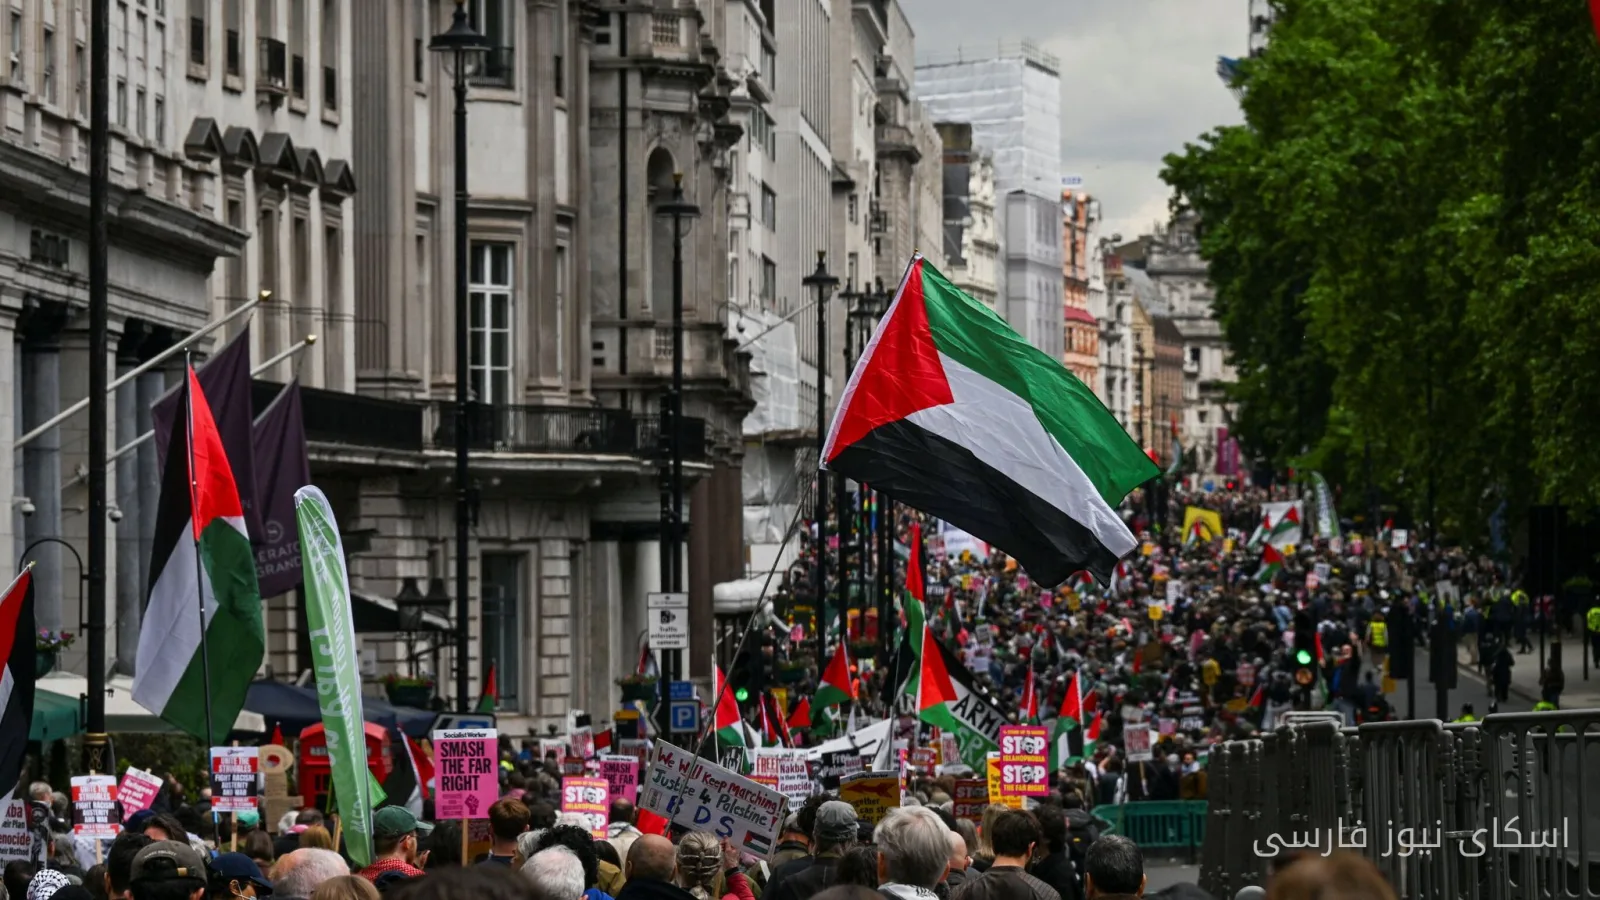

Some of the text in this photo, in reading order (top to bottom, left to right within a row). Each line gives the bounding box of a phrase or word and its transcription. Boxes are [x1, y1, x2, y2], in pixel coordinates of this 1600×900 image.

[678, 708, 691, 726] P
[441, 741, 484, 757] SMASH
[1003, 736, 1045, 754] STOP
[441, 758, 491, 774] THE FAR
[604, 762, 630, 773] SMASH
[658, 747, 675, 768] We
[679, 758, 703, 780] Wll
[702, 772, 727, 793] Keep
[780, 764, 804, 774] Nakba
[1003, 765, 1045, 783] STOP
[442, 775, 479, 792] RIGHT
[620, 774, 634, 785] FAR
[780, 782, 812, 792] Genocide
[565, 786, 606, 804] STOP
[610, 785, 625, 795] GHT
[699, 788, 711, 806] 4
[12, 820, 25, 828] Plan
[693, 805, 711, 824] D
[715, 815, 735, 838] S
[0, 832, 30, 846] enocide
